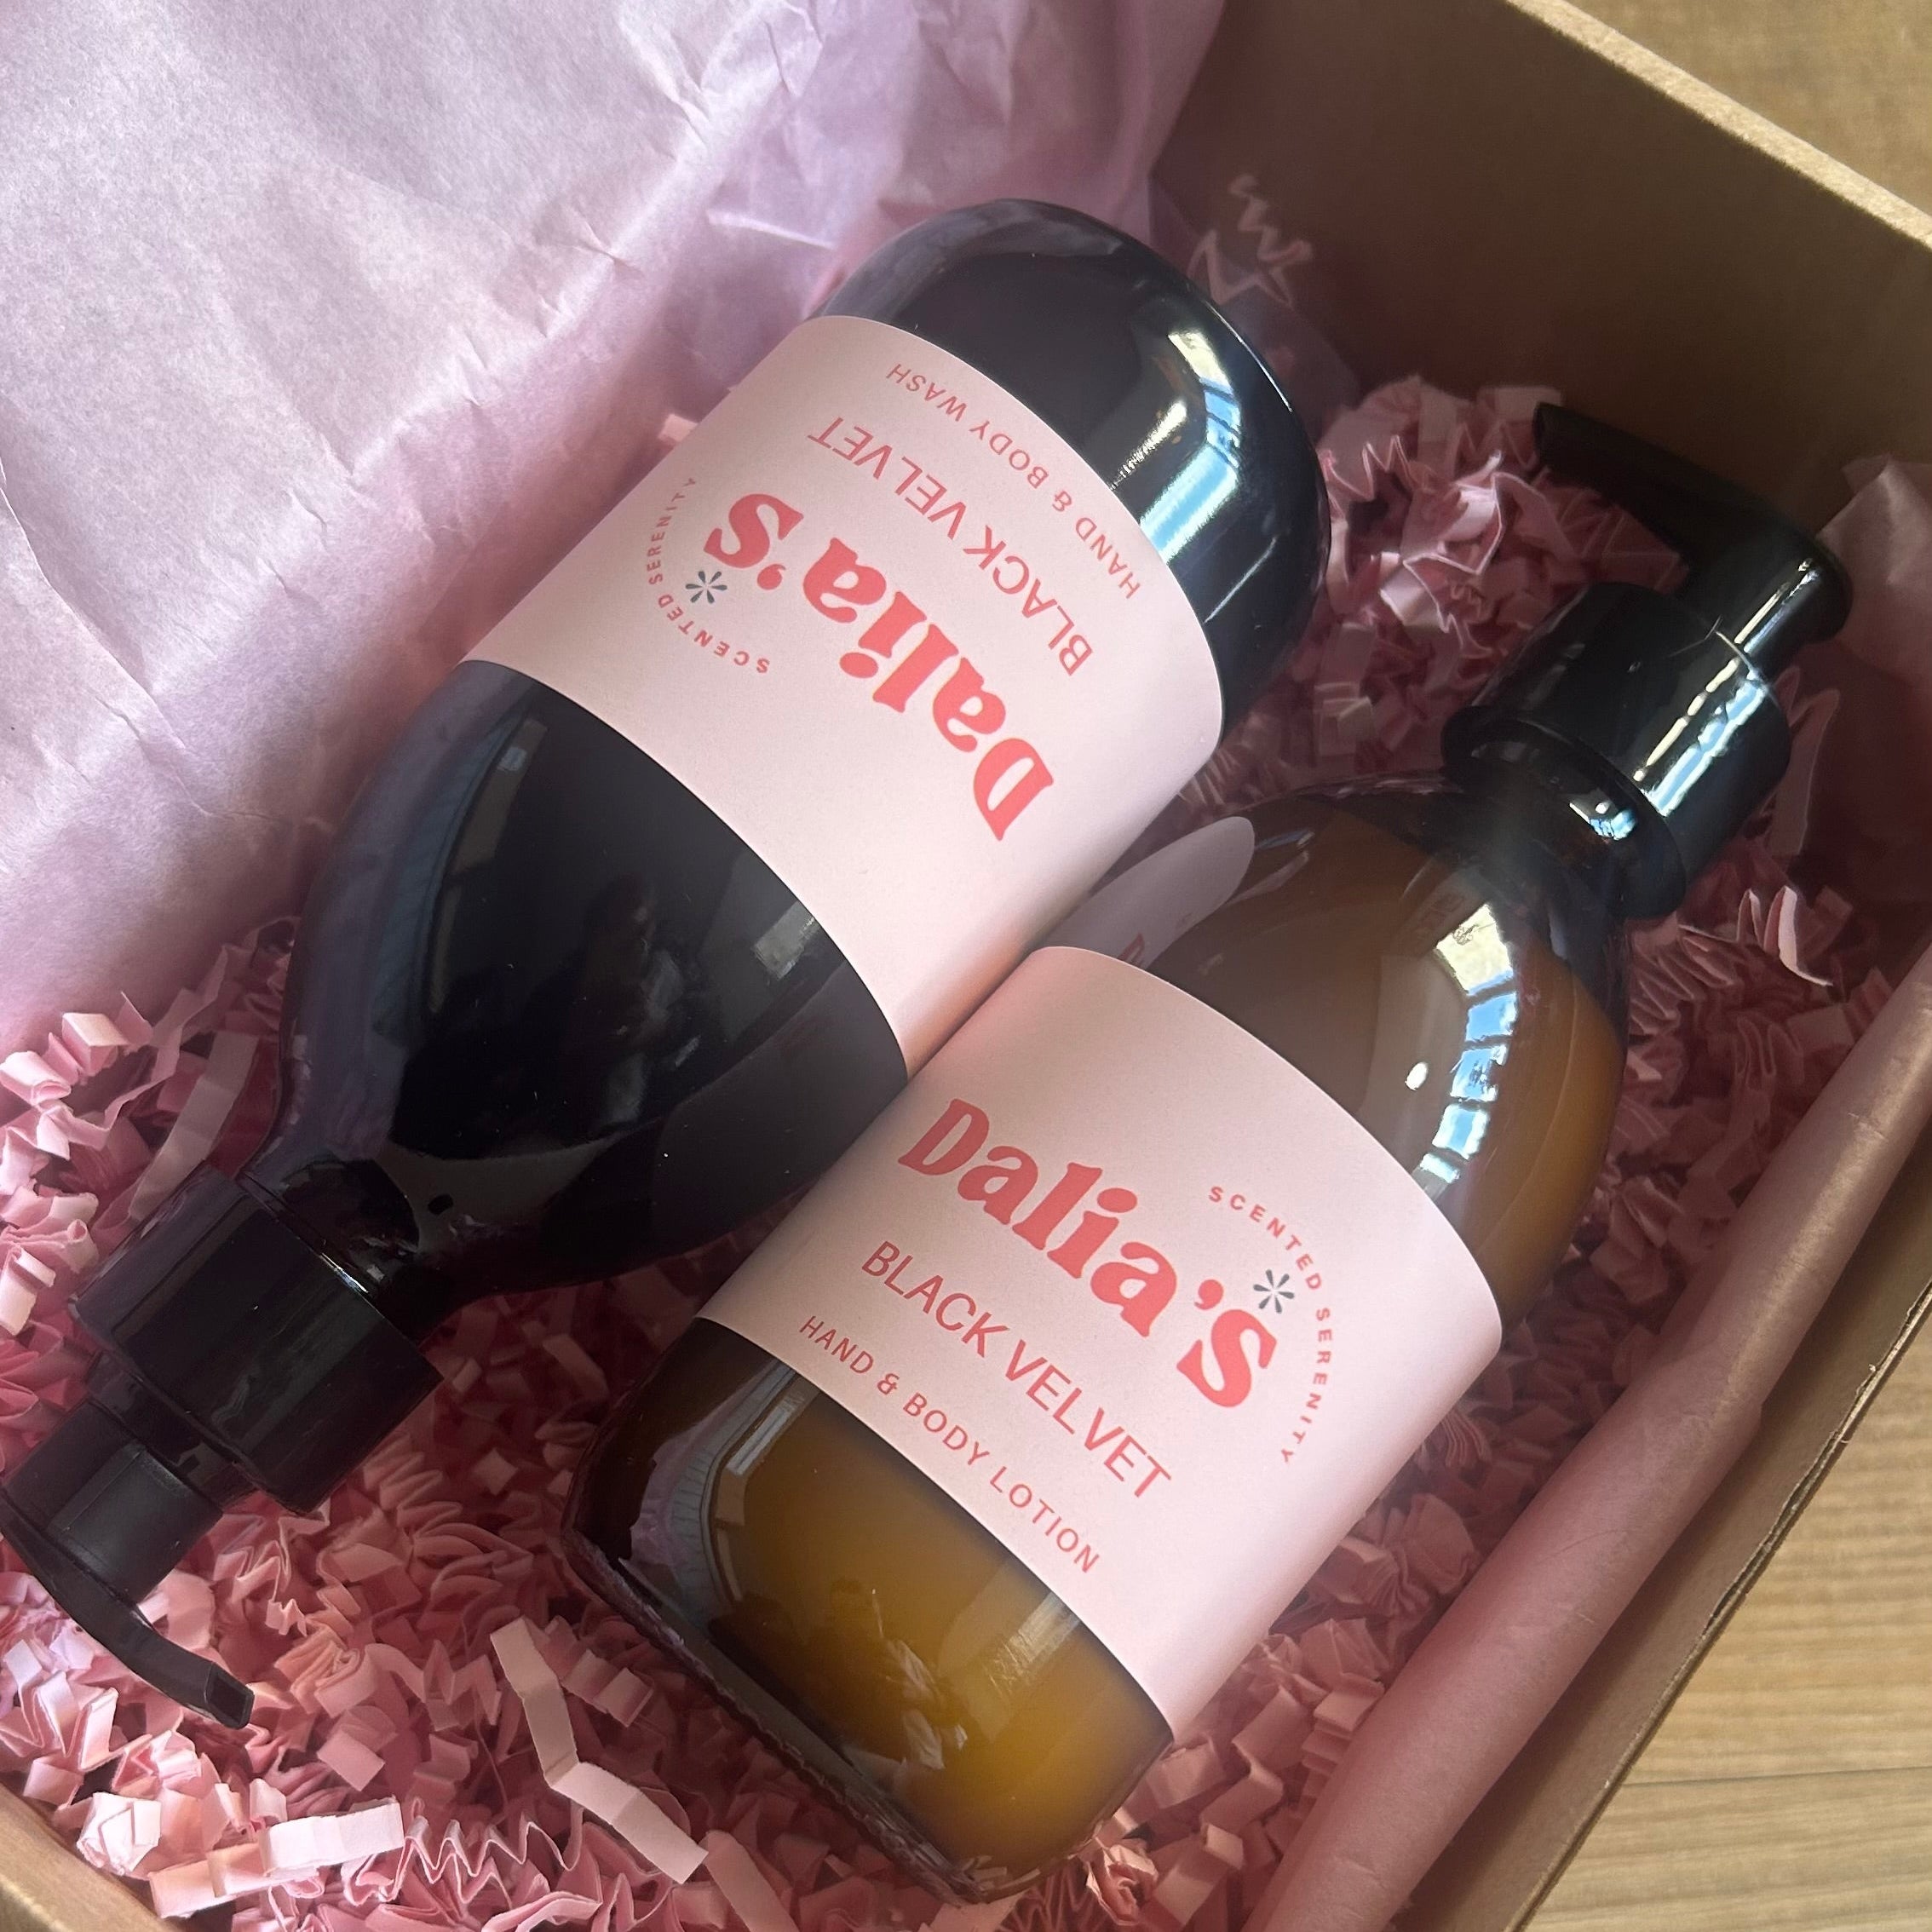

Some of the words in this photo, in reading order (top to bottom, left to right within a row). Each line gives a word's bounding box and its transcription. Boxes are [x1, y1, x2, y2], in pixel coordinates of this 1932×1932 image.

[886, 362, 968, 422] WASH
[807, 416, 968, 540] VELVET
[970, 420, 1050, 490] BODY
[1052, 489, 1073, 513] &
[647, 478, 696, 585] SERENITY
[1074, 515, 1141, 600] HAND
[658, 594, 770, 674] SCENTED
[963, 524, 1094, 677] BLACK
[703, 492, 1055, 842] Dalia's
[898, 1098, 1278, 1408] Dalia's
[861, 1240, 1009, 1358] BLACK
[1004, 1338, 1172, 1499] VELVET
[1208, 1186, 1323, 1291] SCENTED
[1280, 1307, 1334, 1463] SERENITY
[799, 1314, 875, 1375] HAND
[877, 1372, 900, 1396] &
[902, 1391, 991, 1467] BODY
[989, 1465, 1101, 1574] LOTION
